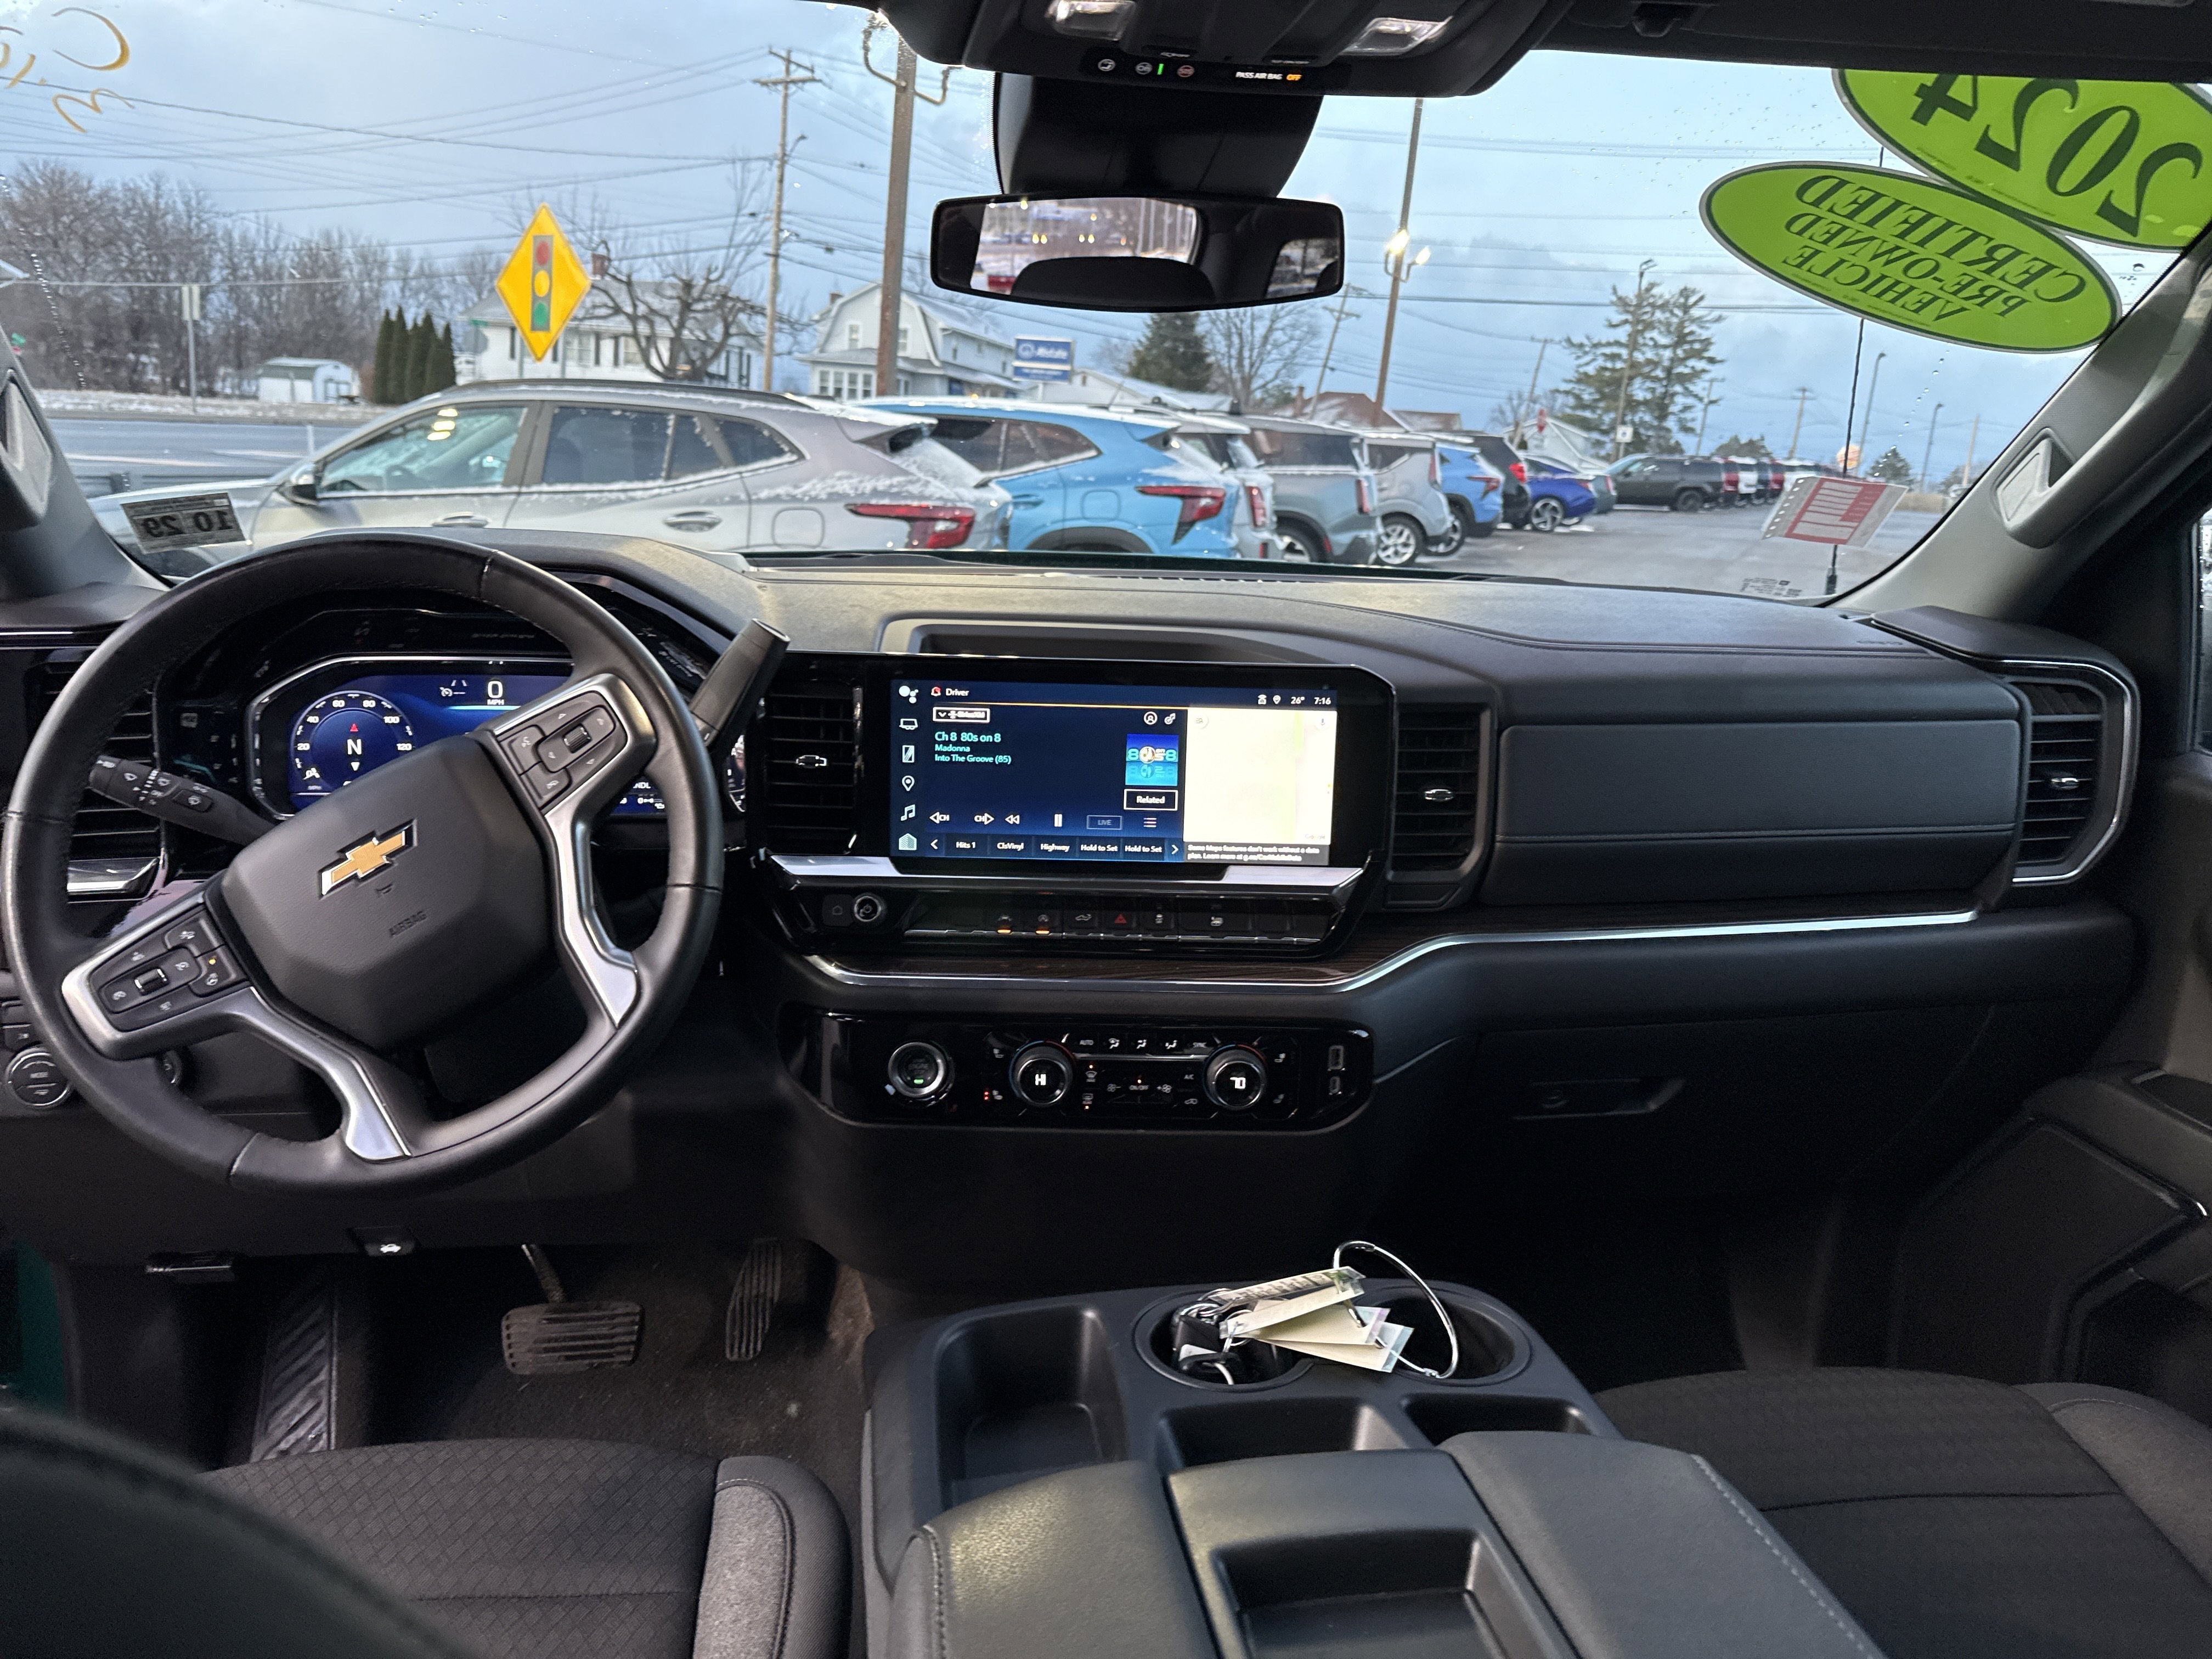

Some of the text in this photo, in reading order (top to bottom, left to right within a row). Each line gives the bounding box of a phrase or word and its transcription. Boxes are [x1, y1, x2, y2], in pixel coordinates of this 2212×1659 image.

[487, 680, 504, 699] 0
[945, 688, 969, 696] Driver
[332, 699, 345, 708] 60
[363, 699, 376, 708] 80
[1290, 696, 1331, 706] 26° 7:16
[306, 715, 319, 724] 40
[383, 715, 399, 724] 100
[935, 731, 949, 741] Ch
[950, 732, 957, 741] 8
[961, 732, 979, 742] 80s
[994, 733, 1001, 742] 8
[347, 738, 363, 755] N
[396, 743, 412, 751] 120
[935, 743, 970, 752] Madonna
[951, 754, 966, 762] The
[995, 755, 1012, 765] (85)
[997, 842, 1024, 851] ClsVinyl
[1040, 843, 1070, 852] Highway
[1035, 1074, 1046, 1086] HI
[1229, 1077, 1246, 1089] 70
